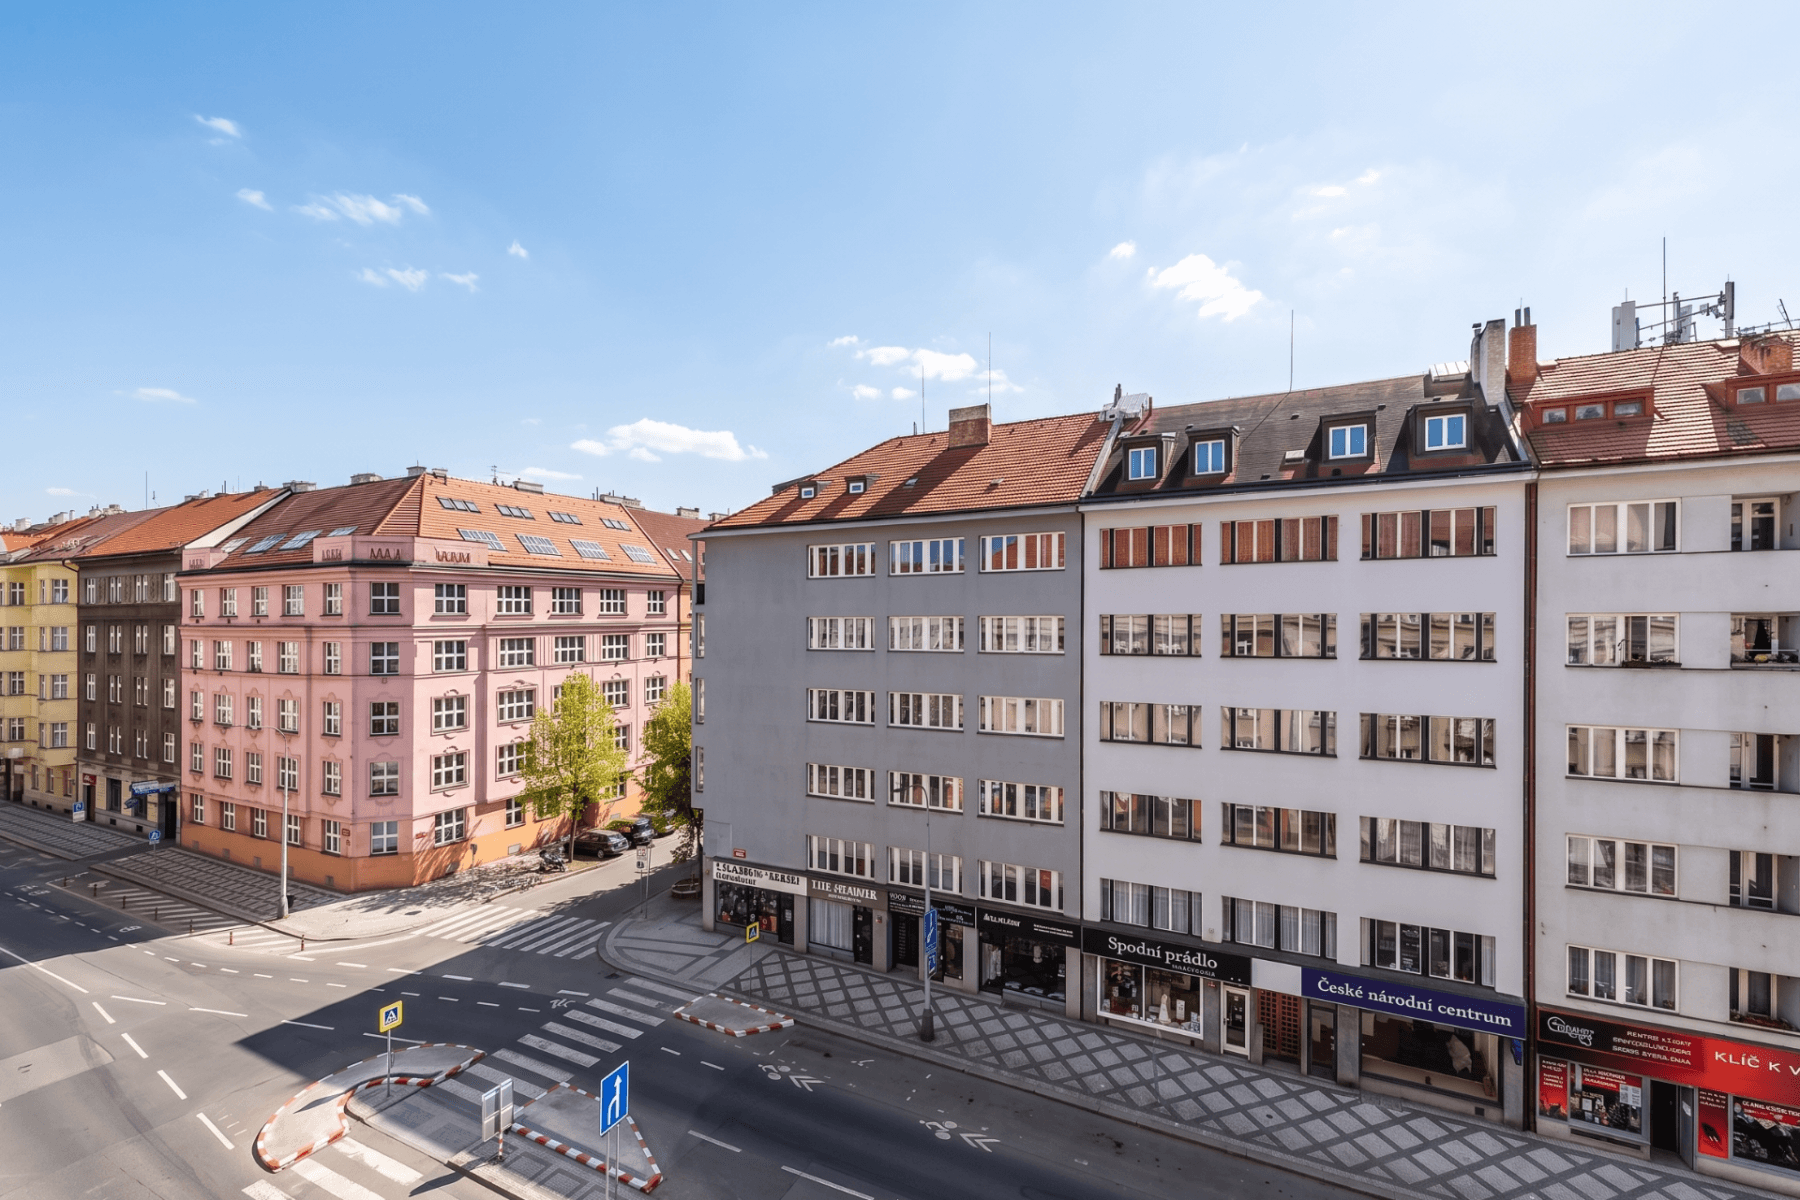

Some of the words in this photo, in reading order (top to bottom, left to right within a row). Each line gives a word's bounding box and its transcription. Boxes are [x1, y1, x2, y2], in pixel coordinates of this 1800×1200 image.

[1108, 936, 1162, 959] Spodní
[1164, 950, 1218, 969] prádlo
[1317, 976, 1364, 999] České
[1368, 988, 1433, 1012] národní
[1437, 1004, 1512, 1027] centrum
[1714, 1051, 1760, 1069] KLÍČ
[1768, 1061, 1781, 1073] K
